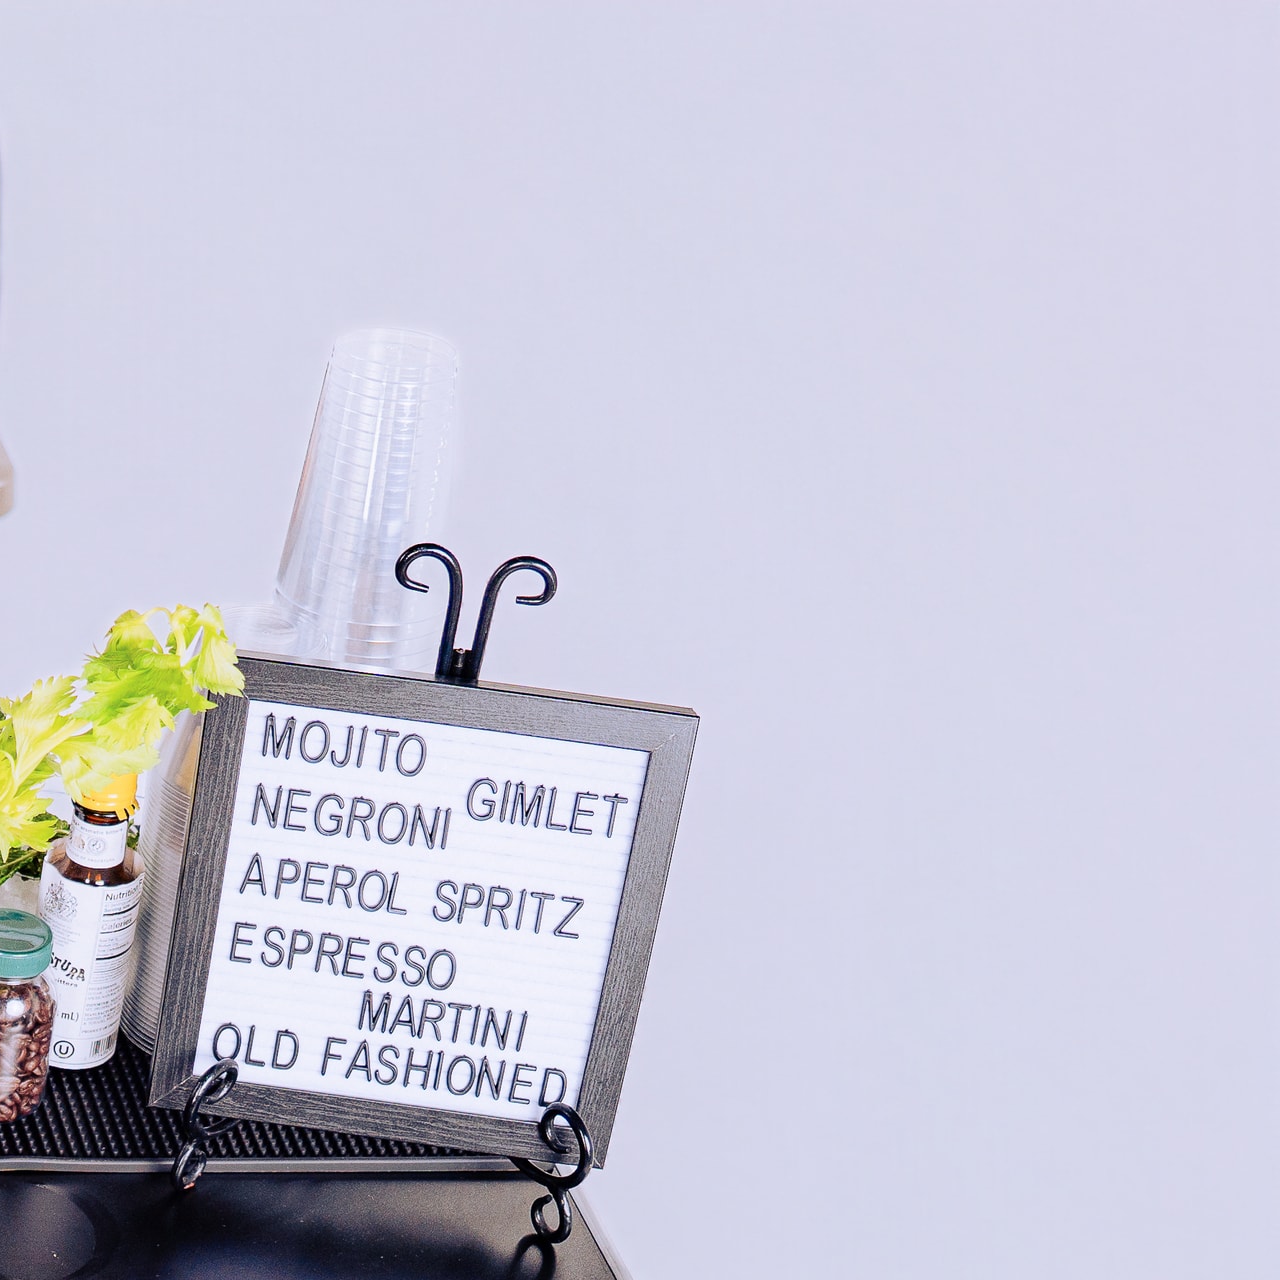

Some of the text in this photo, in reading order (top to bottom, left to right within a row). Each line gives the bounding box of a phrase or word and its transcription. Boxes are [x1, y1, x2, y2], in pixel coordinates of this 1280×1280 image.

[262, 714, 427, 777] MOJITO
[251, 783, 452, 850] NEGRONI
[466, 777, 627, 838] GIMLET
[239, 853, 585, 939] APEROL SPRITZ
[229, 922, 457, 990] ESPRESSO
[357, 990, 528, 1052] MARTINI
[212, 1022, 568, 1107] OLD FASHIONED
